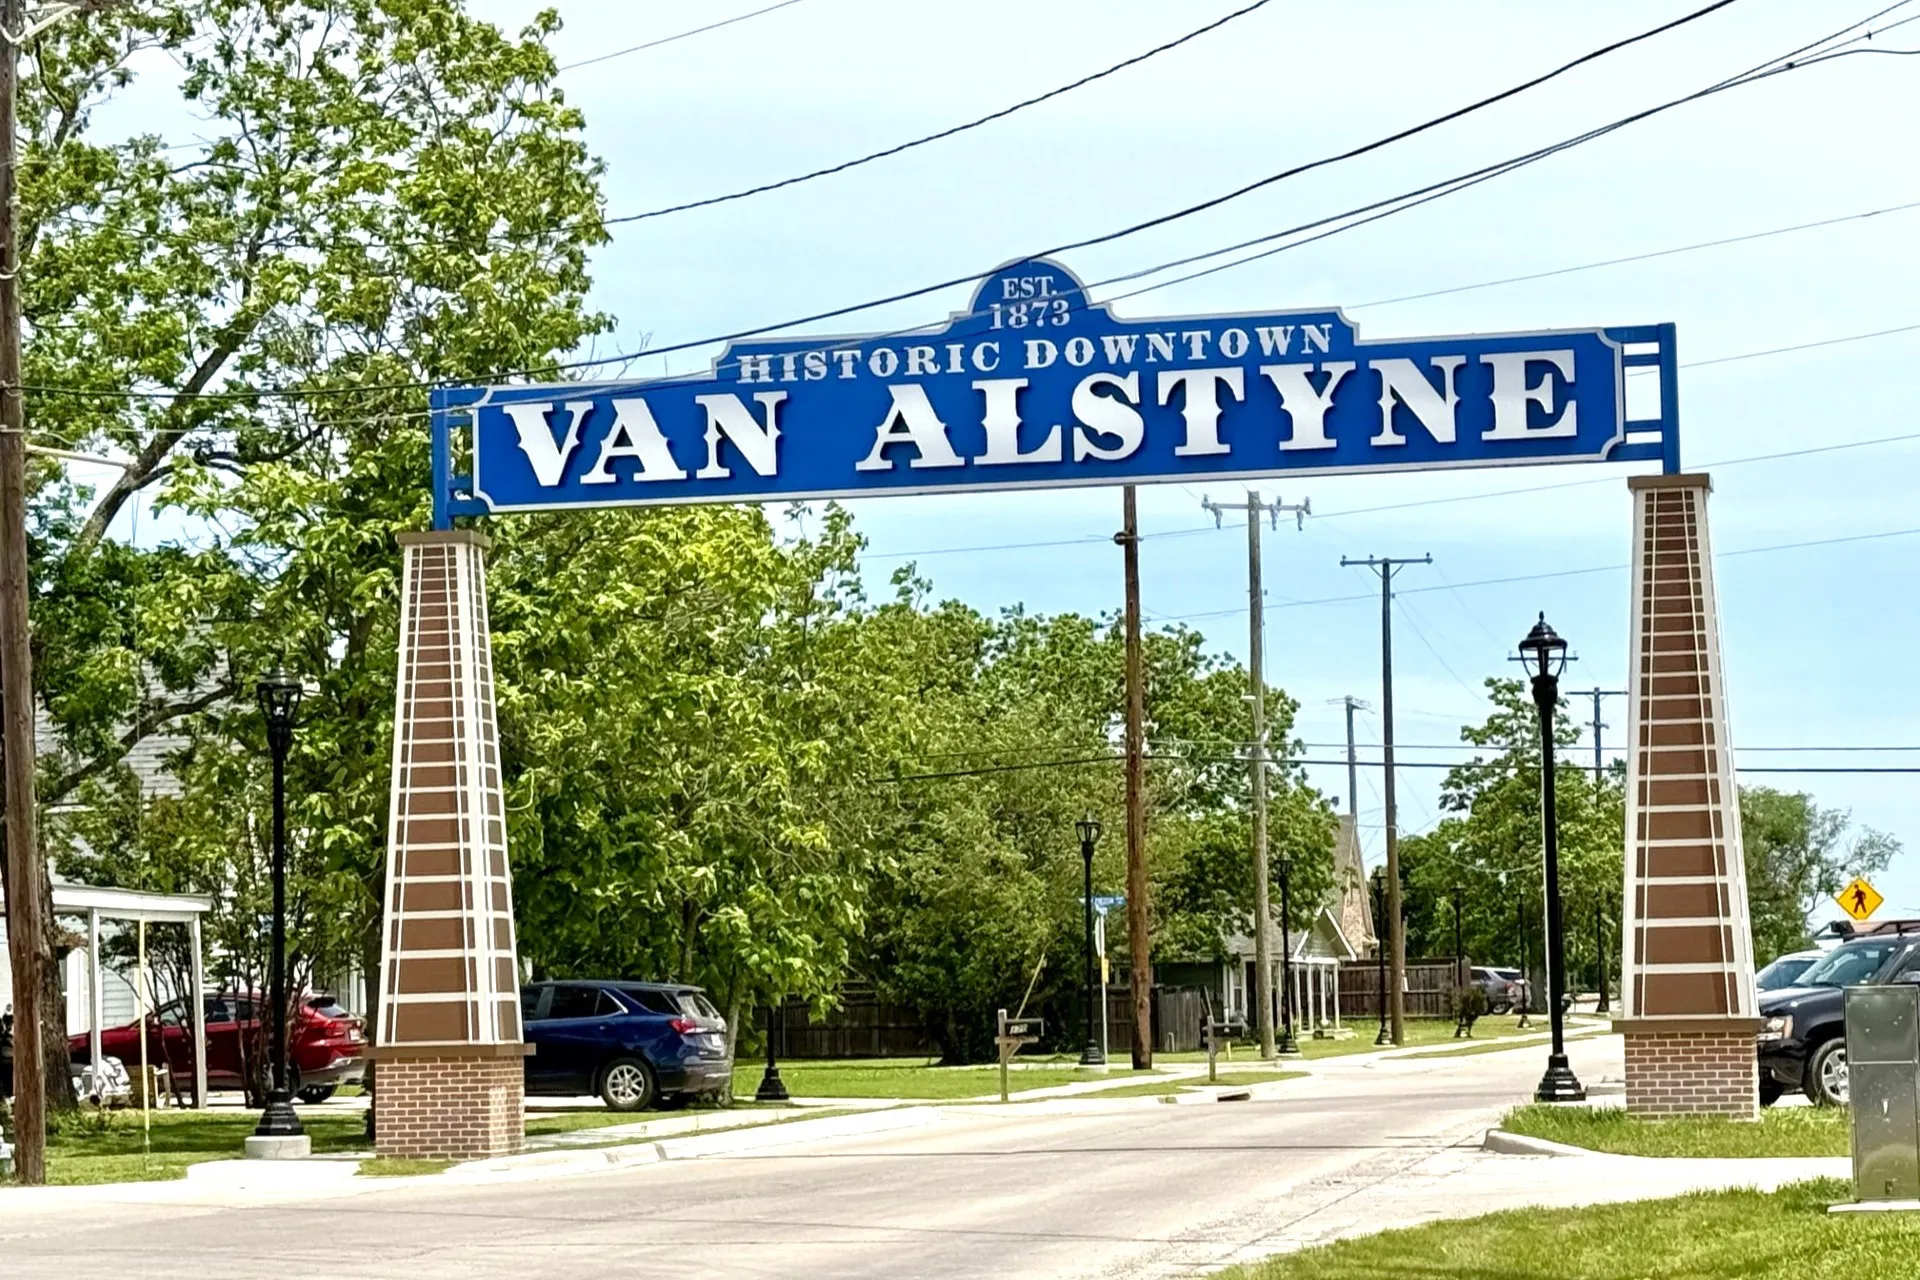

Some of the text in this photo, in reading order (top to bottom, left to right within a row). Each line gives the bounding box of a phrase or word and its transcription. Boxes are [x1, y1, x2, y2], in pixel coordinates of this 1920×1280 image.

[1001, 275, 1058, 300] EST.
[989, 299, 1071, 330] 1873
[736, 323, 1334, 384] HISTORIC DOWNTOWN
[502, 348, 1578, 487] VAN ALSTYNE
